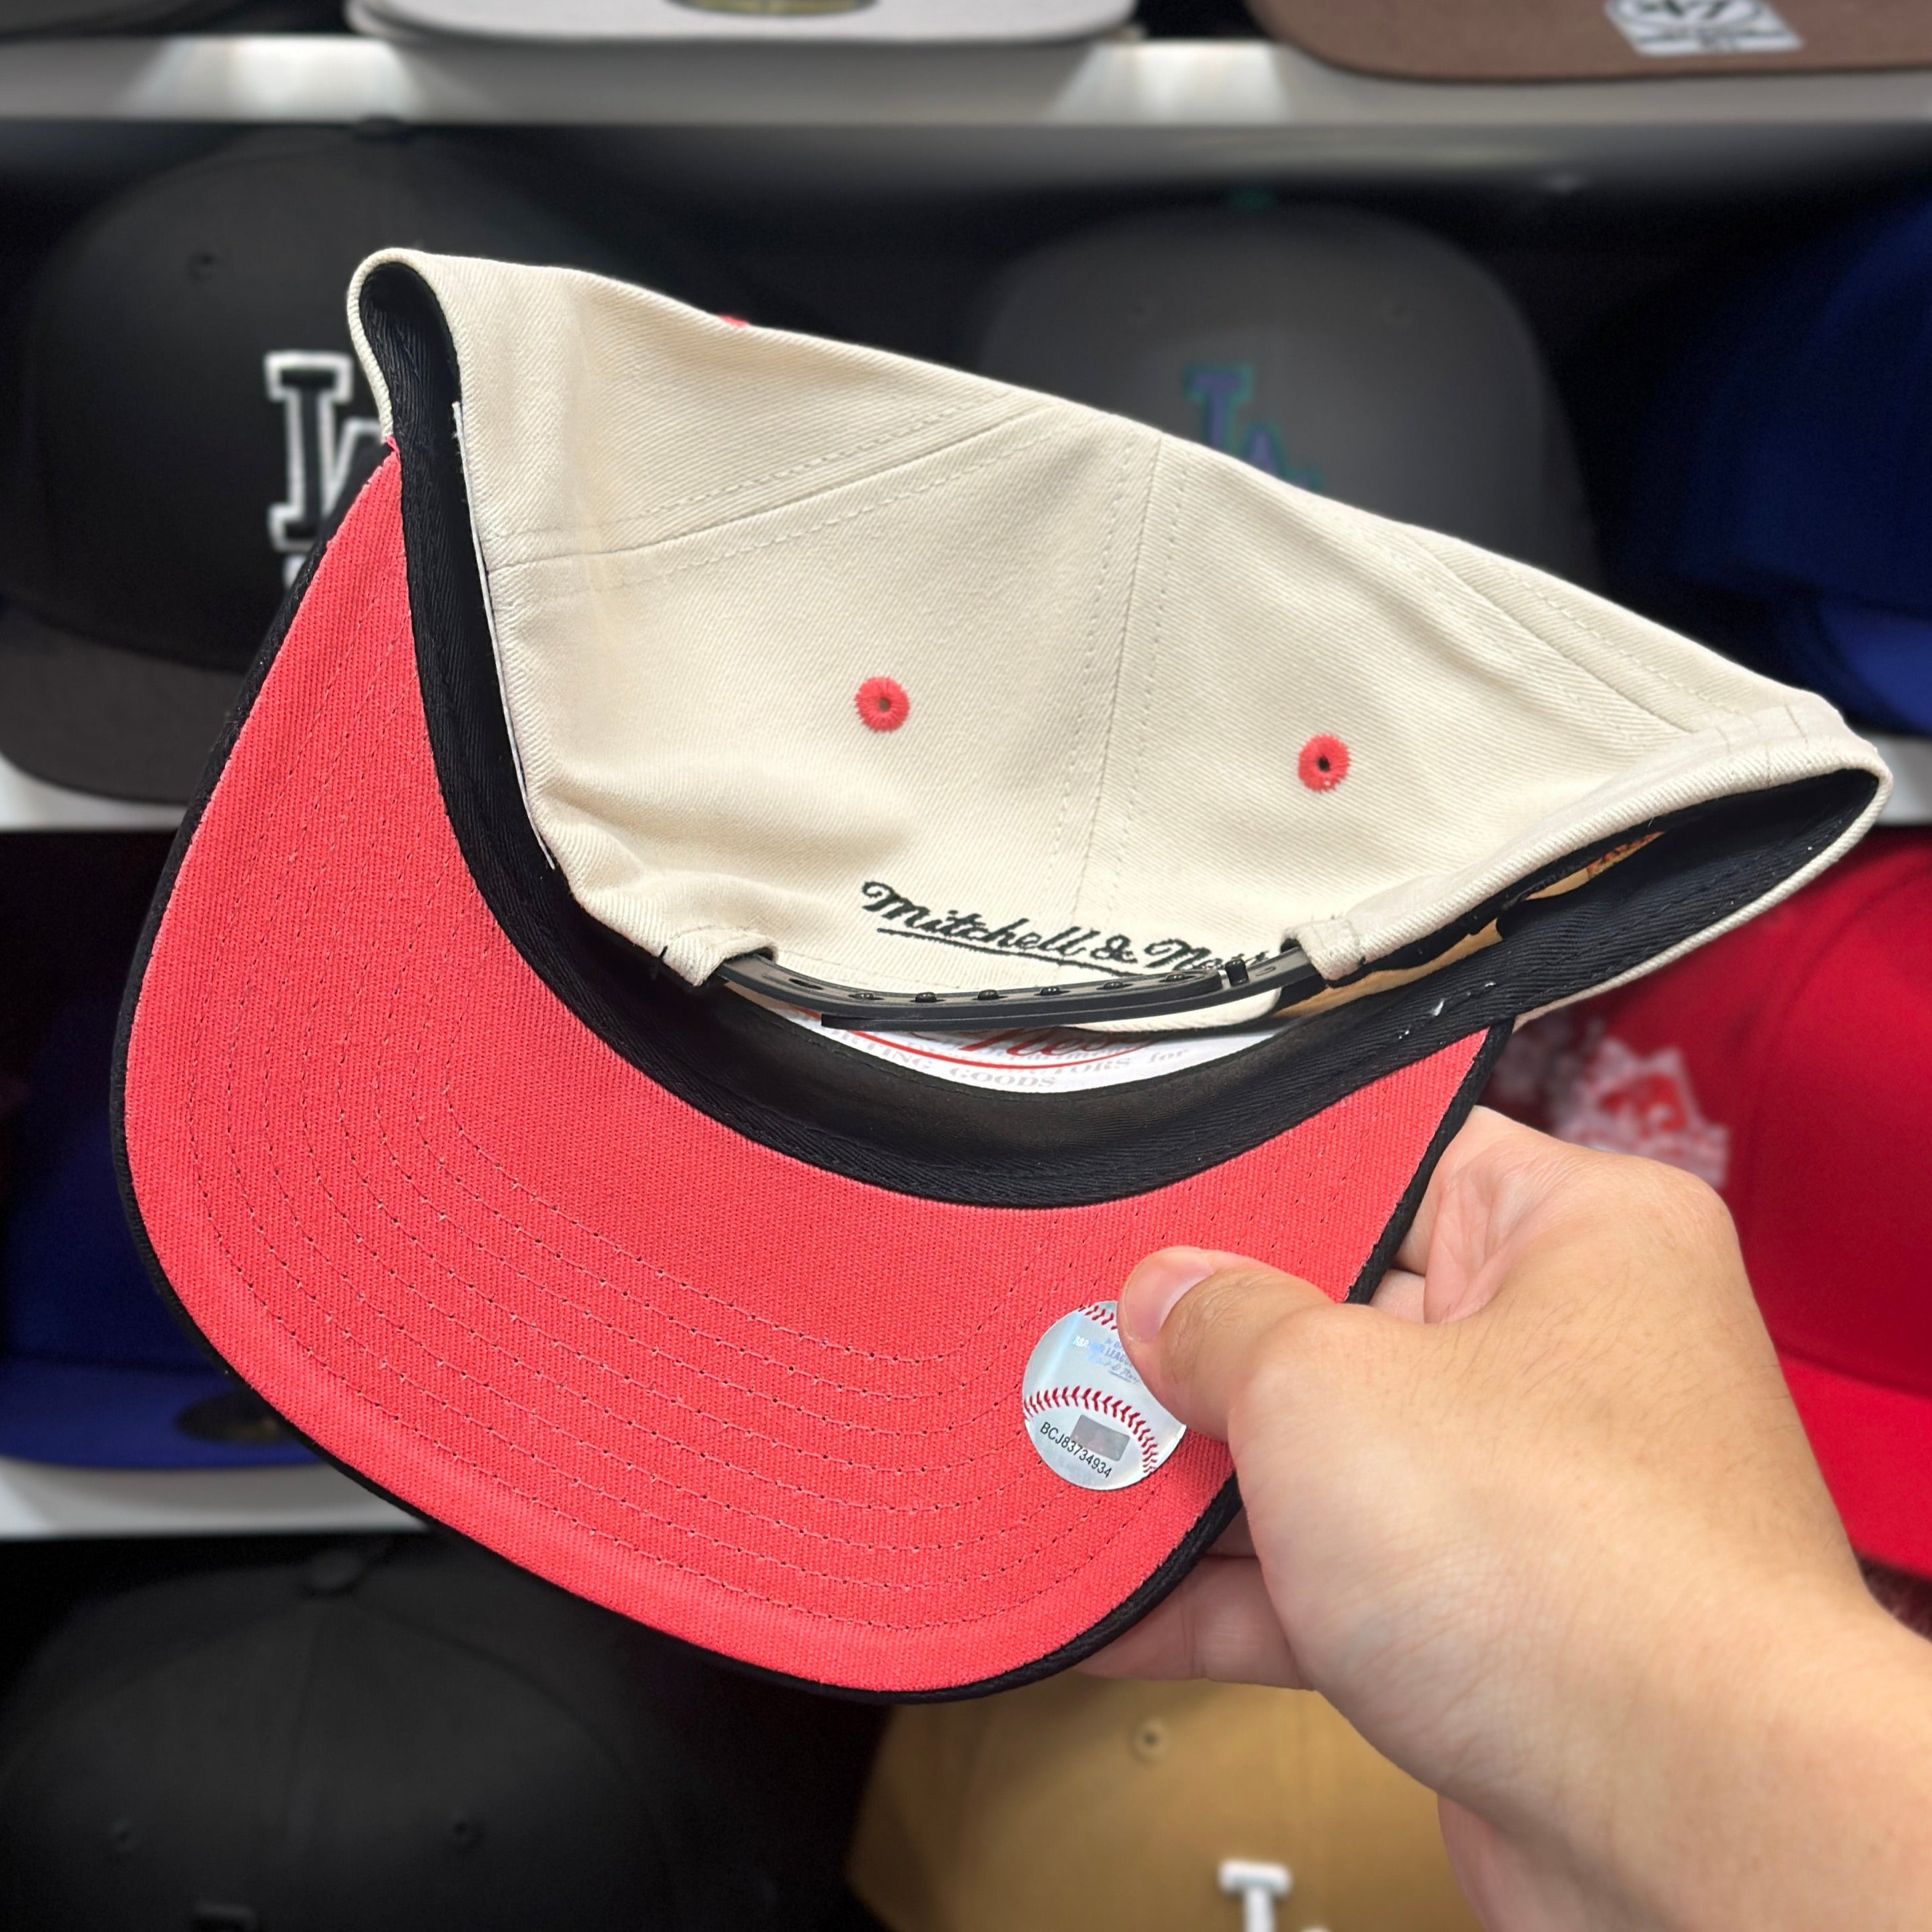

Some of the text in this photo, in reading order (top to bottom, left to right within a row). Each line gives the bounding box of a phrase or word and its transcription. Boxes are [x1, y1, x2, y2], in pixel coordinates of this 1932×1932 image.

[862, 881, 1101, 956] Mitchell
[1090, 935, 1138, 963] &
[949, 1067, 1057, 1087] GOODS
[1040, 1421, 1113, 1477] BCJ83734934
